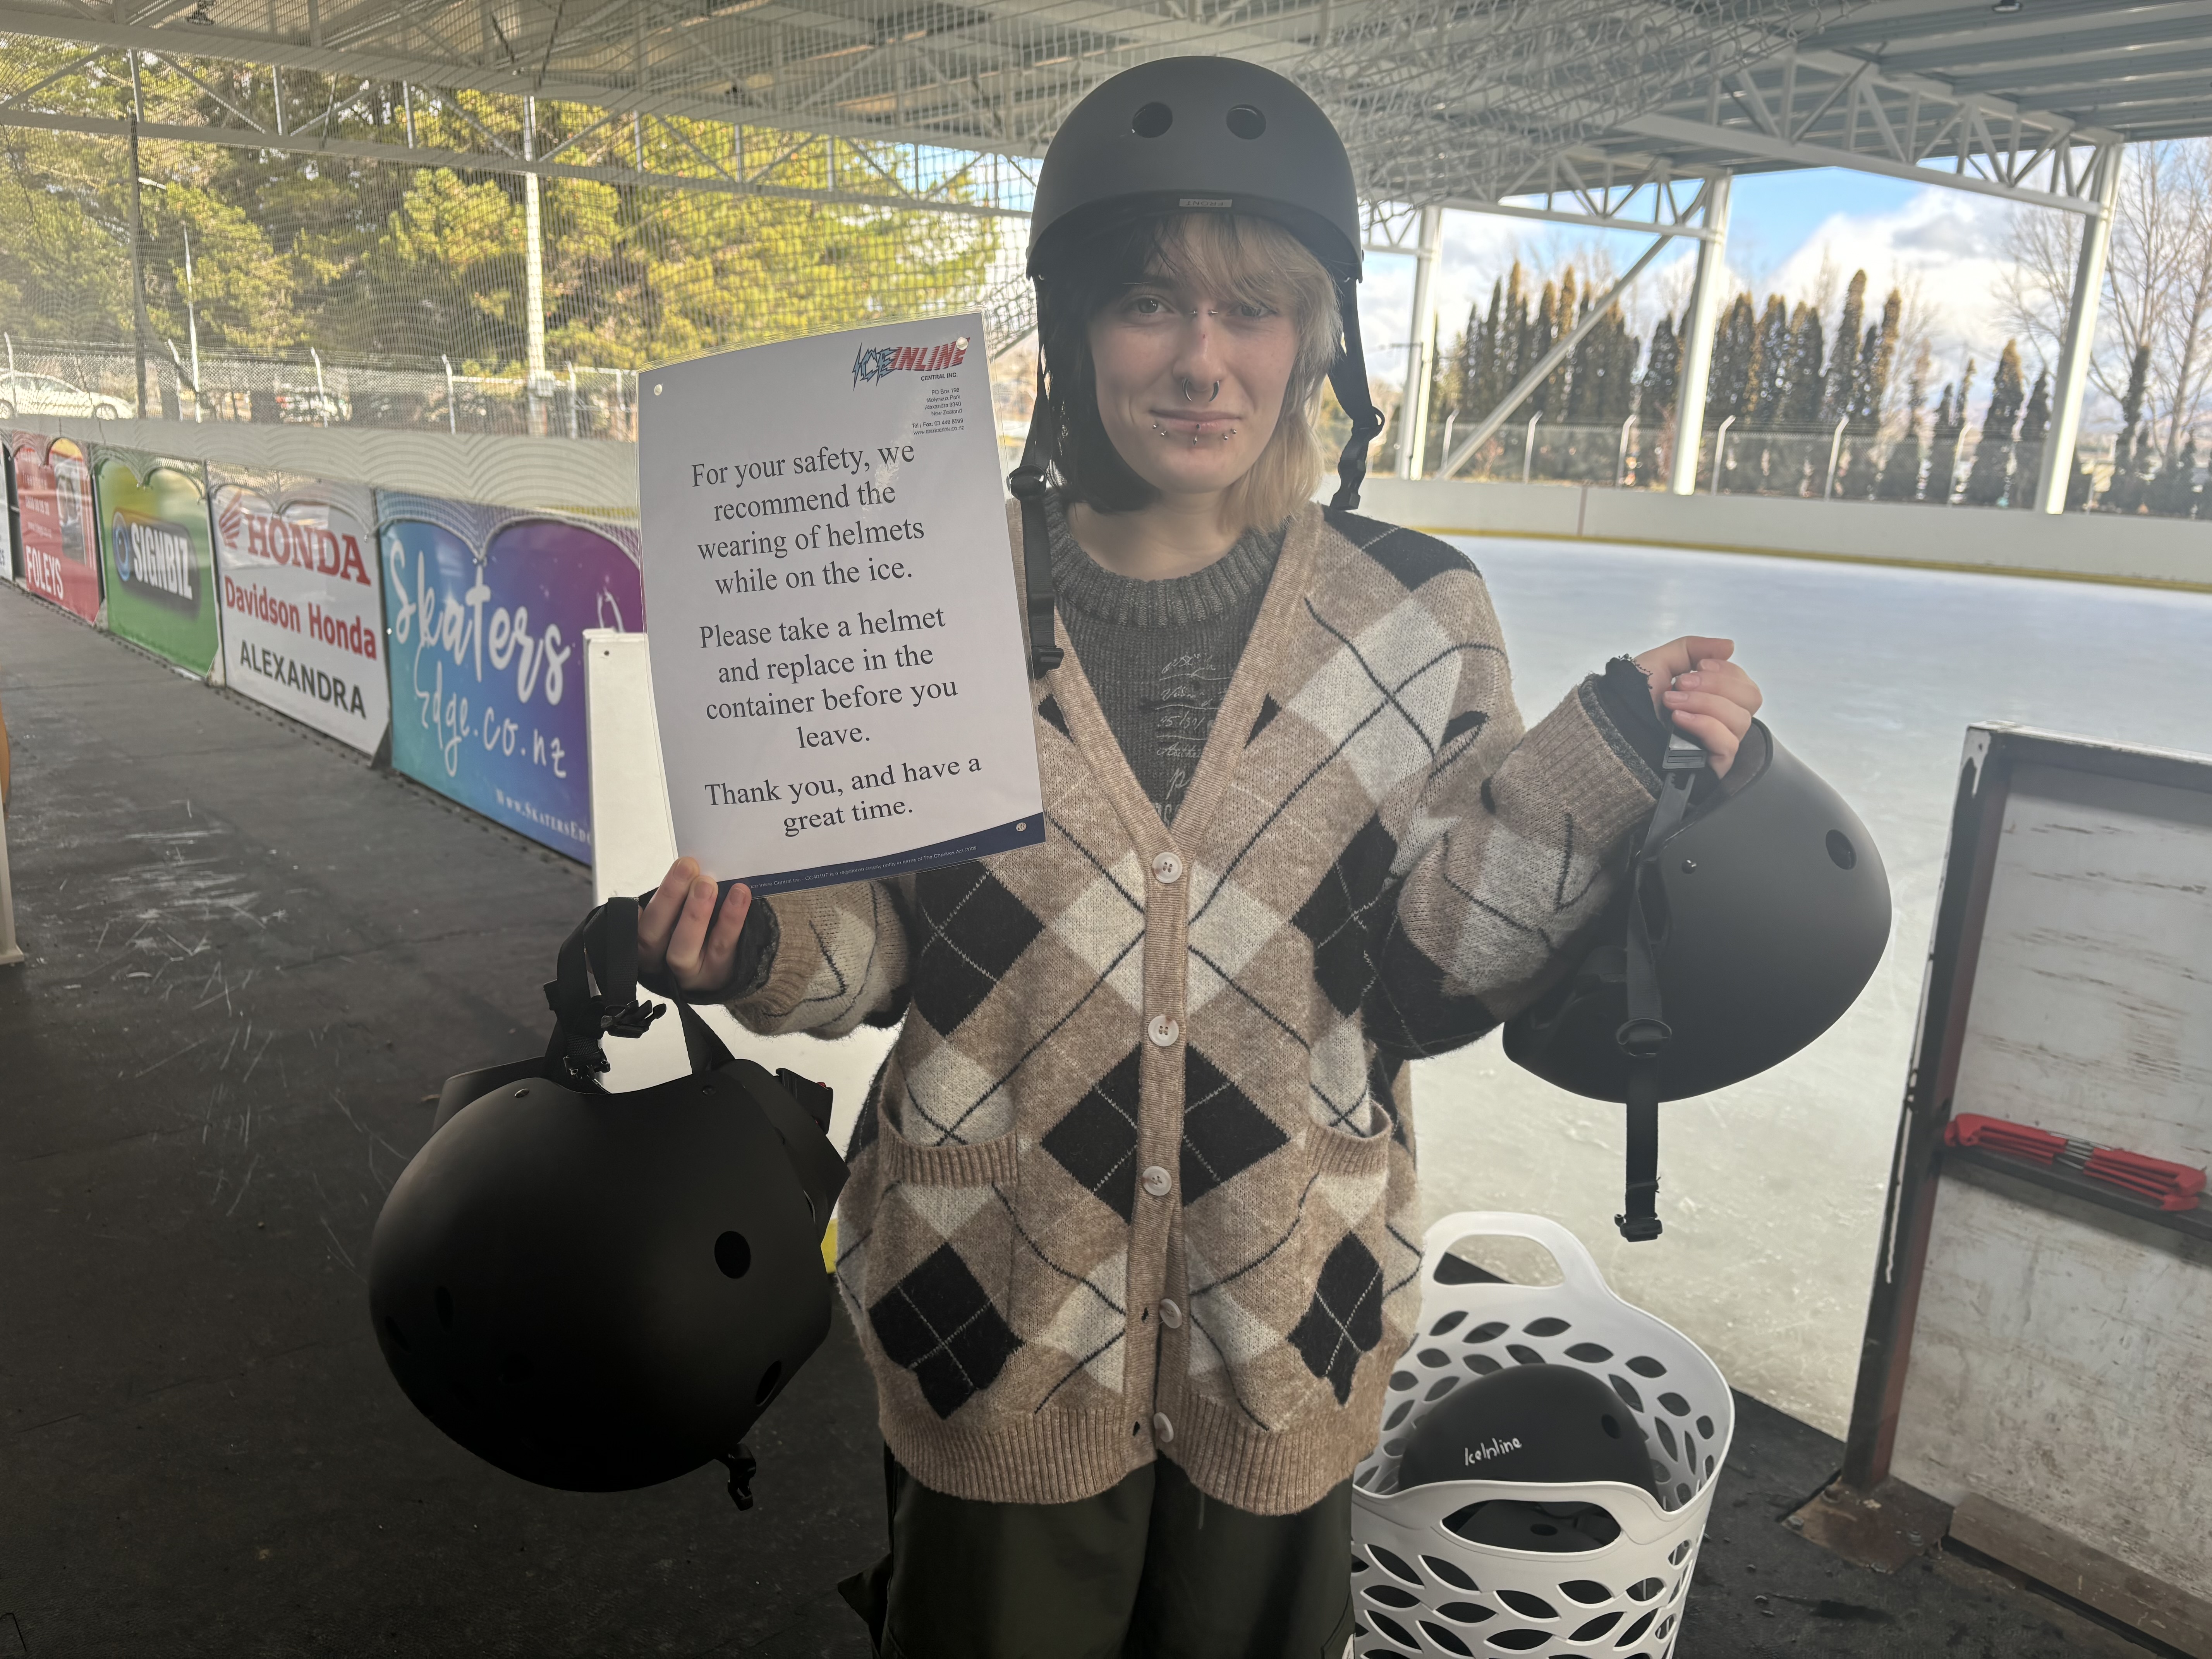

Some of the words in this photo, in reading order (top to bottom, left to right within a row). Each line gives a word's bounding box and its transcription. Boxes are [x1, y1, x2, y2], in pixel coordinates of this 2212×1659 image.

[692, 464, 727, 487] For
[734, 459, 785, 488] your
[793, 447, 870, 475] safety,
[877, 444, 914, 465] we
[714, 483, 850, 521] recommend
[857, 481, 895, 505] the
[244, 514, 371, 586] HONDA
[697, 531, 787, 559] wearing
[795, 524, 821, 550] of
[826, 519, 924, 547] helmets
[26, 545, 64, 600] FOLEYS
[131, 522, 192, 600] SIGNBIZ
[715, 568, 778, 595] while
[786, 570, 816, 588] on
[822, 561, 860, 585] the
[869, 558, 911, 581] ice.
[225, 575, 301, 633] Davidson
[308, 601, 377, 661] Honda
[390, 541, 570, 705] Skaters
[699, 625, 771, 648] Please
[778, 617, 829, 641] take
[838, 620, 852, 637] a
[857, 607, 946, 635] helmet
[240, 640, 366, 720] ALEXANDRA
[719, 658, 760, 683] and
[766, 654, 854, 684] replace
[862, 649, 888, 672] in
[895, 645, 934, 667] the
[706, 693, 814, 719] container
[821, 685, 902, 710] before
[910, 680, 958, 707] you
[797, 726, 870, 748] leave.
[705, 780, 782, 805] Thank
[788, 778, 843, 804] you,
[852, 765, 896, 790] and
[902, 757, 960, 783] have
[968, 758, 982, 771] a
[784, 807, 845, 837] great
[852, 801, 913, 822] time.
[805, 872, 828, 881] CC40197
